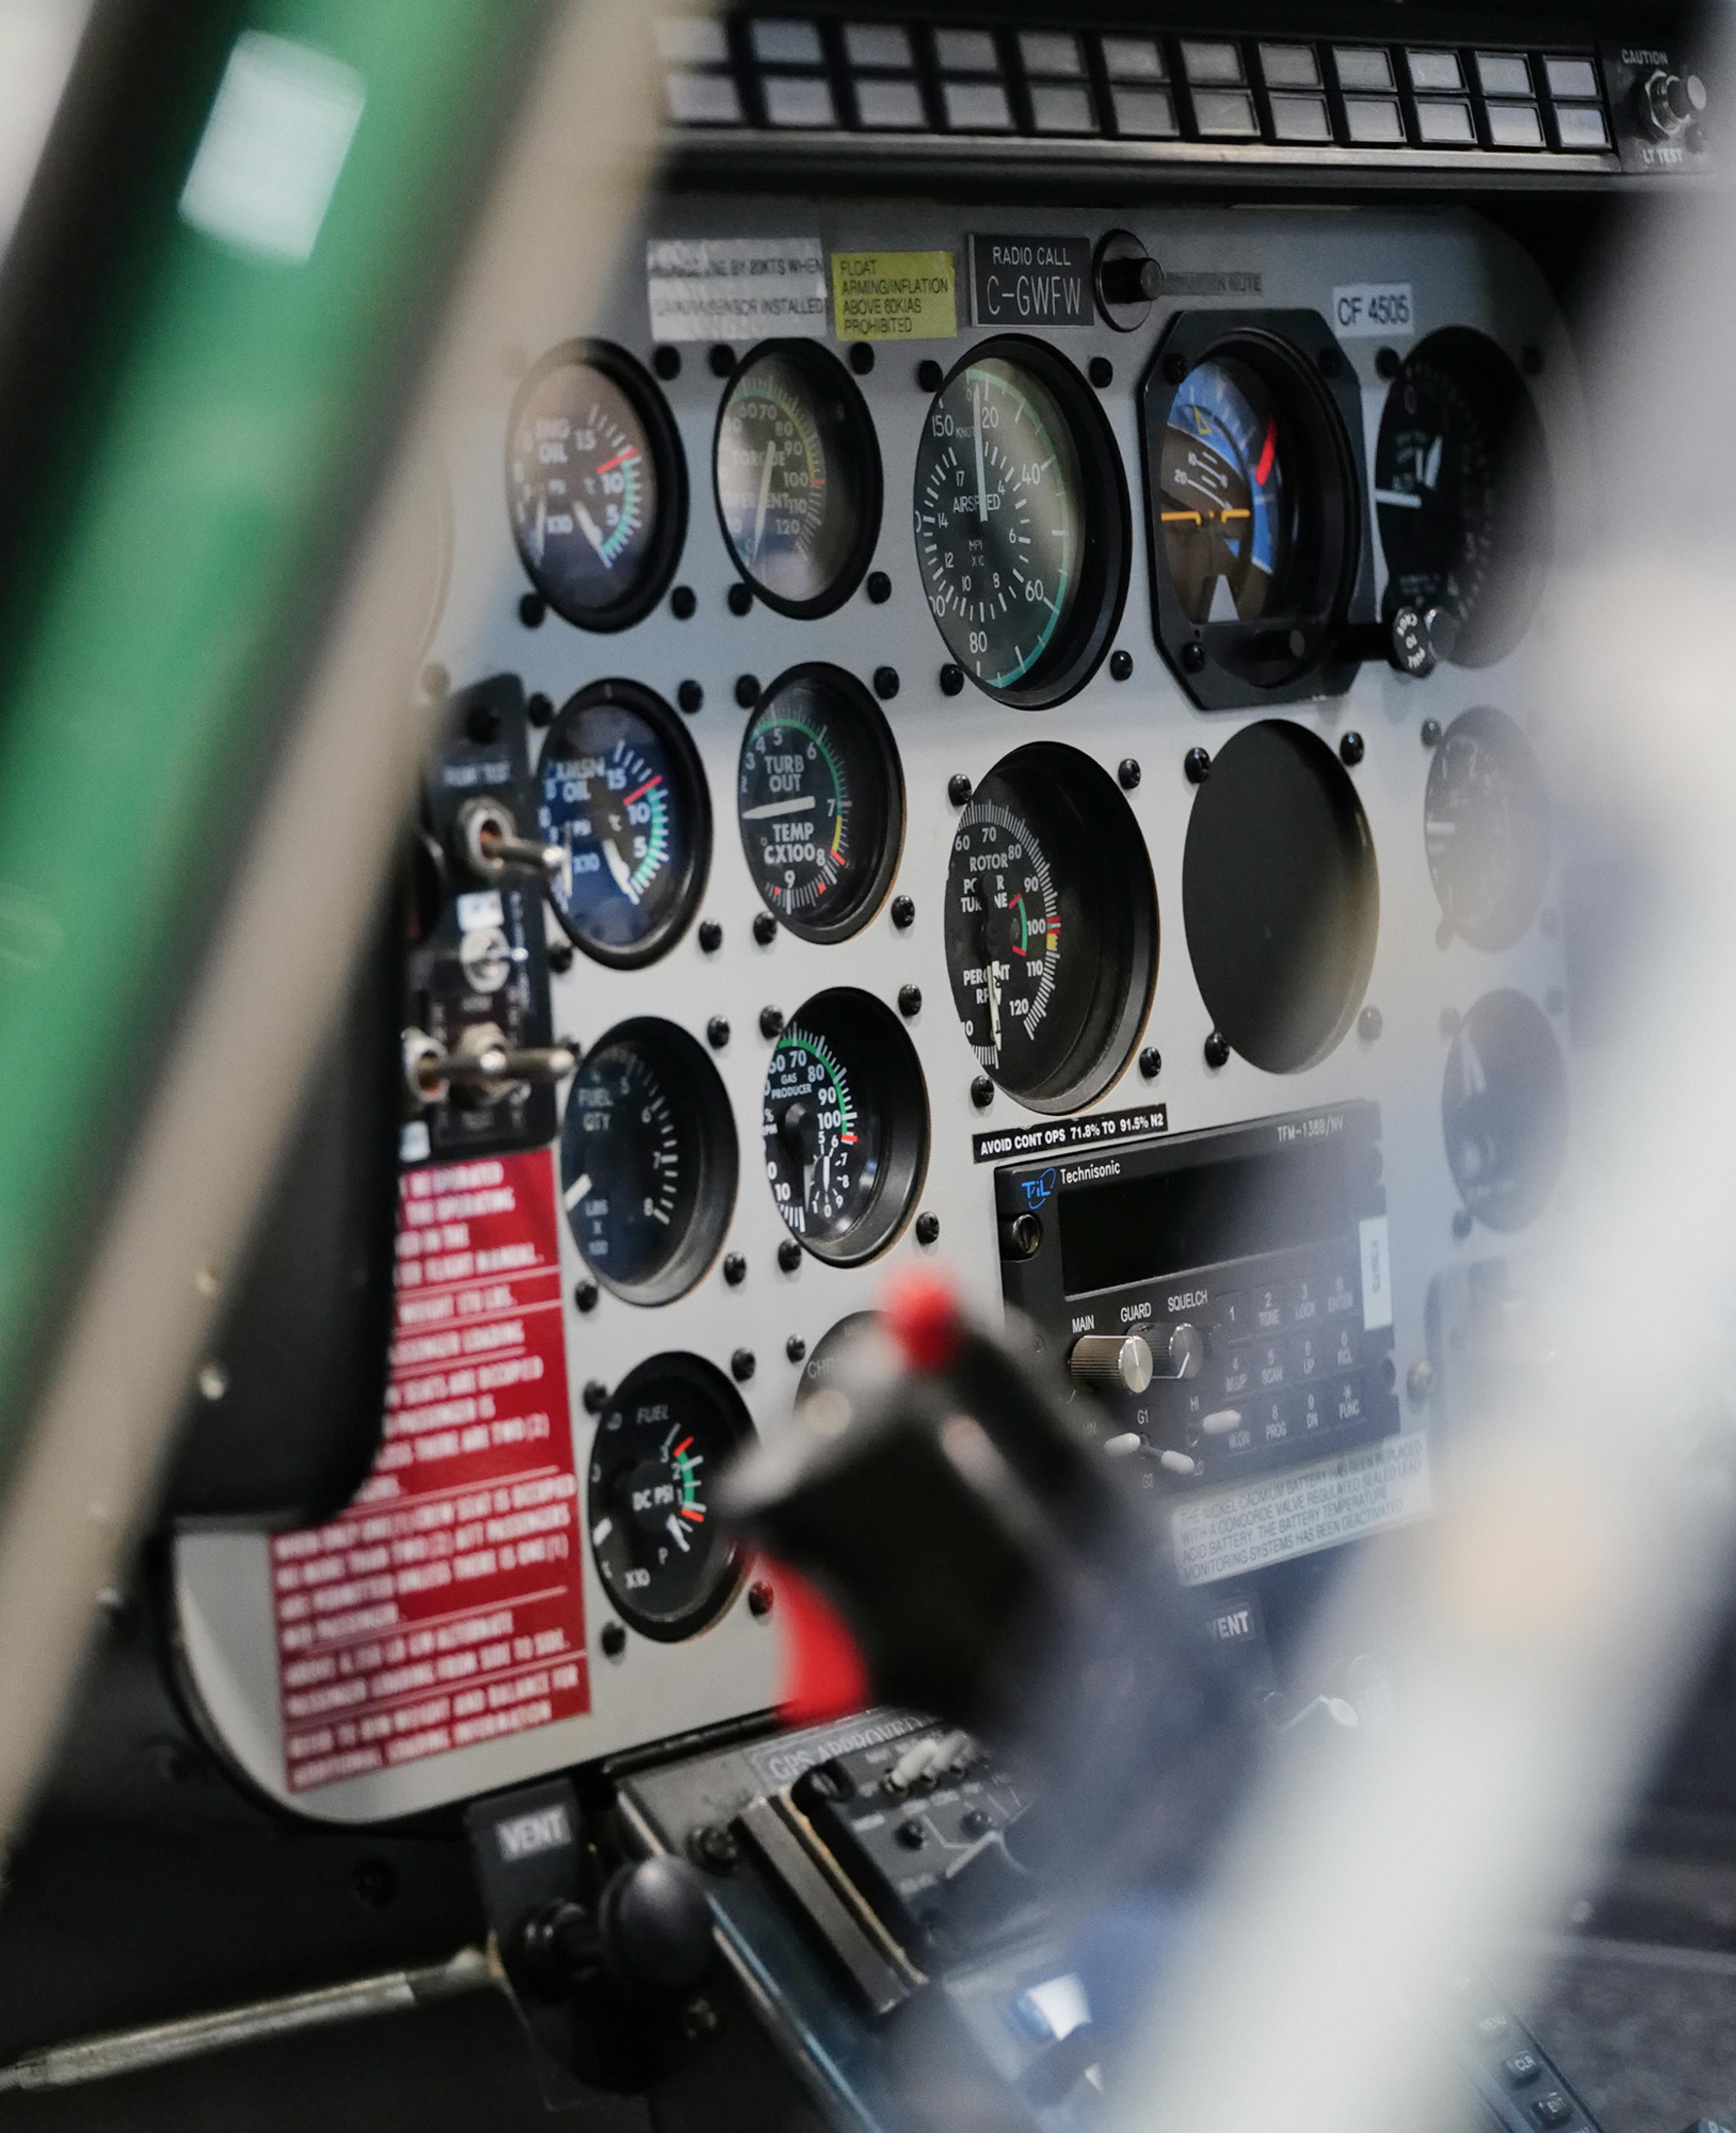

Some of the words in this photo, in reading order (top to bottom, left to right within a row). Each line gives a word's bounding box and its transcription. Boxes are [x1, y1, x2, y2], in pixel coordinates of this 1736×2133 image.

[1622, 49, 1669, 66] CAUTION
[1656, 148, 1683, 163] TEST
[993, 247, 1033, 265] RADIO
[1037, 247, 1071, 265] CALL
[840, 259, 877, 276] FLOAT
[986, 275, 1081, 316] C-GWFW
[760, 297, 824, 316] INSTALLED
[844, 298, 882, 315] ABOVE
[1338, 298, 1361, 326] CF
[1367, 294, 1410, 325] 4505
[844, 317, 913, 335] PROHIBITED
[759, 403, 778, 421] 70
[981, 407, 999, 429] 20
[775, 421, 794, 437] 80
[932, 414, 954, 437] 150
[783, 440, 803, 457] 90
[783, 472, 809, 487] 100
[956, 470, 965, 487] 17
[1021, 463, 1041, 485] 40
[998, 480, 1006, 495] 4
[953, 493, 1001, 513] AIRSPED
[776, 518, 800, 535] 120
[938, 512, 948, 528] 14
[1009, 528, 1016, 544] 6
[945, 552, 954, 568] 12
[962, 576, 972, 591] 10
[993, 572, 1000, 588] 8
[1025, 579, 1044, 602] 60
[969, 631, 988, 654] 80
[755, 735, 766, 755] 4
[774, 728, 783, 746] 5
[807, 742, 817, 760] 6
[745, 752, 755, 771] 3
[764, 755, 805, 774] TURB
[769, 774, 802, 793] OUT
[627, 801, 651, 825] 10
[827, 799, 836, 817] 7
[772, 822, 814, 843] TEMP
[981, 827, 997, 843] 70
[633, 835, 648, 858] 5
[955, 835, 970, 851] 60
[1008, 844, 1022, 860] 80
[816, 848, 826, 867] 8
[969, 853, 1009, 872] ROTOR
[784, 870, 796, 889] 9
[1024, 876, 1039, 893] 90
[1026, 918, 1046, 936] 100
[1026, 960, 1044, 977] 110
[1009, 998, 1030, 1016] 120
[789, 1050, 807, 1068] 70
[781, 1073, 797, 1085] GAS
[807, 1064, 825, 1083] 80
[771, 1083, 812, 1100] PRODUCER
[818, 1087, 836, 1106] 90
[641, 1106, 651, 1124] 6
[817, 1110, 841, 1130] 100
[818, 1131, 825, 1144] 5
[831, 1135, 839, 1148] 6
[980, 1140, 1012, 1156] AVOID
[1014, 1132, 1043, 1149] CONT
[1045, 1128, 1066, 1144] OPS
[1070, 1123, 1101, 1140] 71.8%
[1102, 1121, 1116, 1135] TO
[1120, 1116, 1149, 1132] 91.5%
[1150, 1112, 1164, 1128] N2
[652, 1151, 661, 1169] 7
[840, 1153, 848, 1166] 7
[1059, 1159, 1121, 1185] Technisonic
[842, 1175, 849, 1188] 8
[774, 1182, 791, 1201] 10
[812, 1200, 817, 1214] 1
[824, 1204, 831, 1218] 0
[836, 1195, 844, 1209] 9
[1167, 1290, 1208, 1312] SQUELCH
[1264, 1291, 1272, 1308] 2
[1120, 1302, 1152, 1322] GUARD
[1229, 1305, 1235, 1321] 1
[1072, 1314, 1095, 1334] MAIN
[1137, 1409, 1149, 1425] G1
[1266, 1420, 1287, 1440] PROG
[1286, 1470, 1329, 1495] BATTERY
[1210, 1523, 1217, 1536] A
[1218, 1506, 1273, 1535] CONCORDE
[1275, 1494, 1305, 1515] VALVE
[1183, 1544, 1207, 1564] ACID
[1258, 1524, 1277, 1540] THE
[1278, 1510, 1320, 1533] BATTERY
[1183, 1549, 1248, 1580] MONITORING
[1249, 1534, 1294, 1561] SYSTEMS
